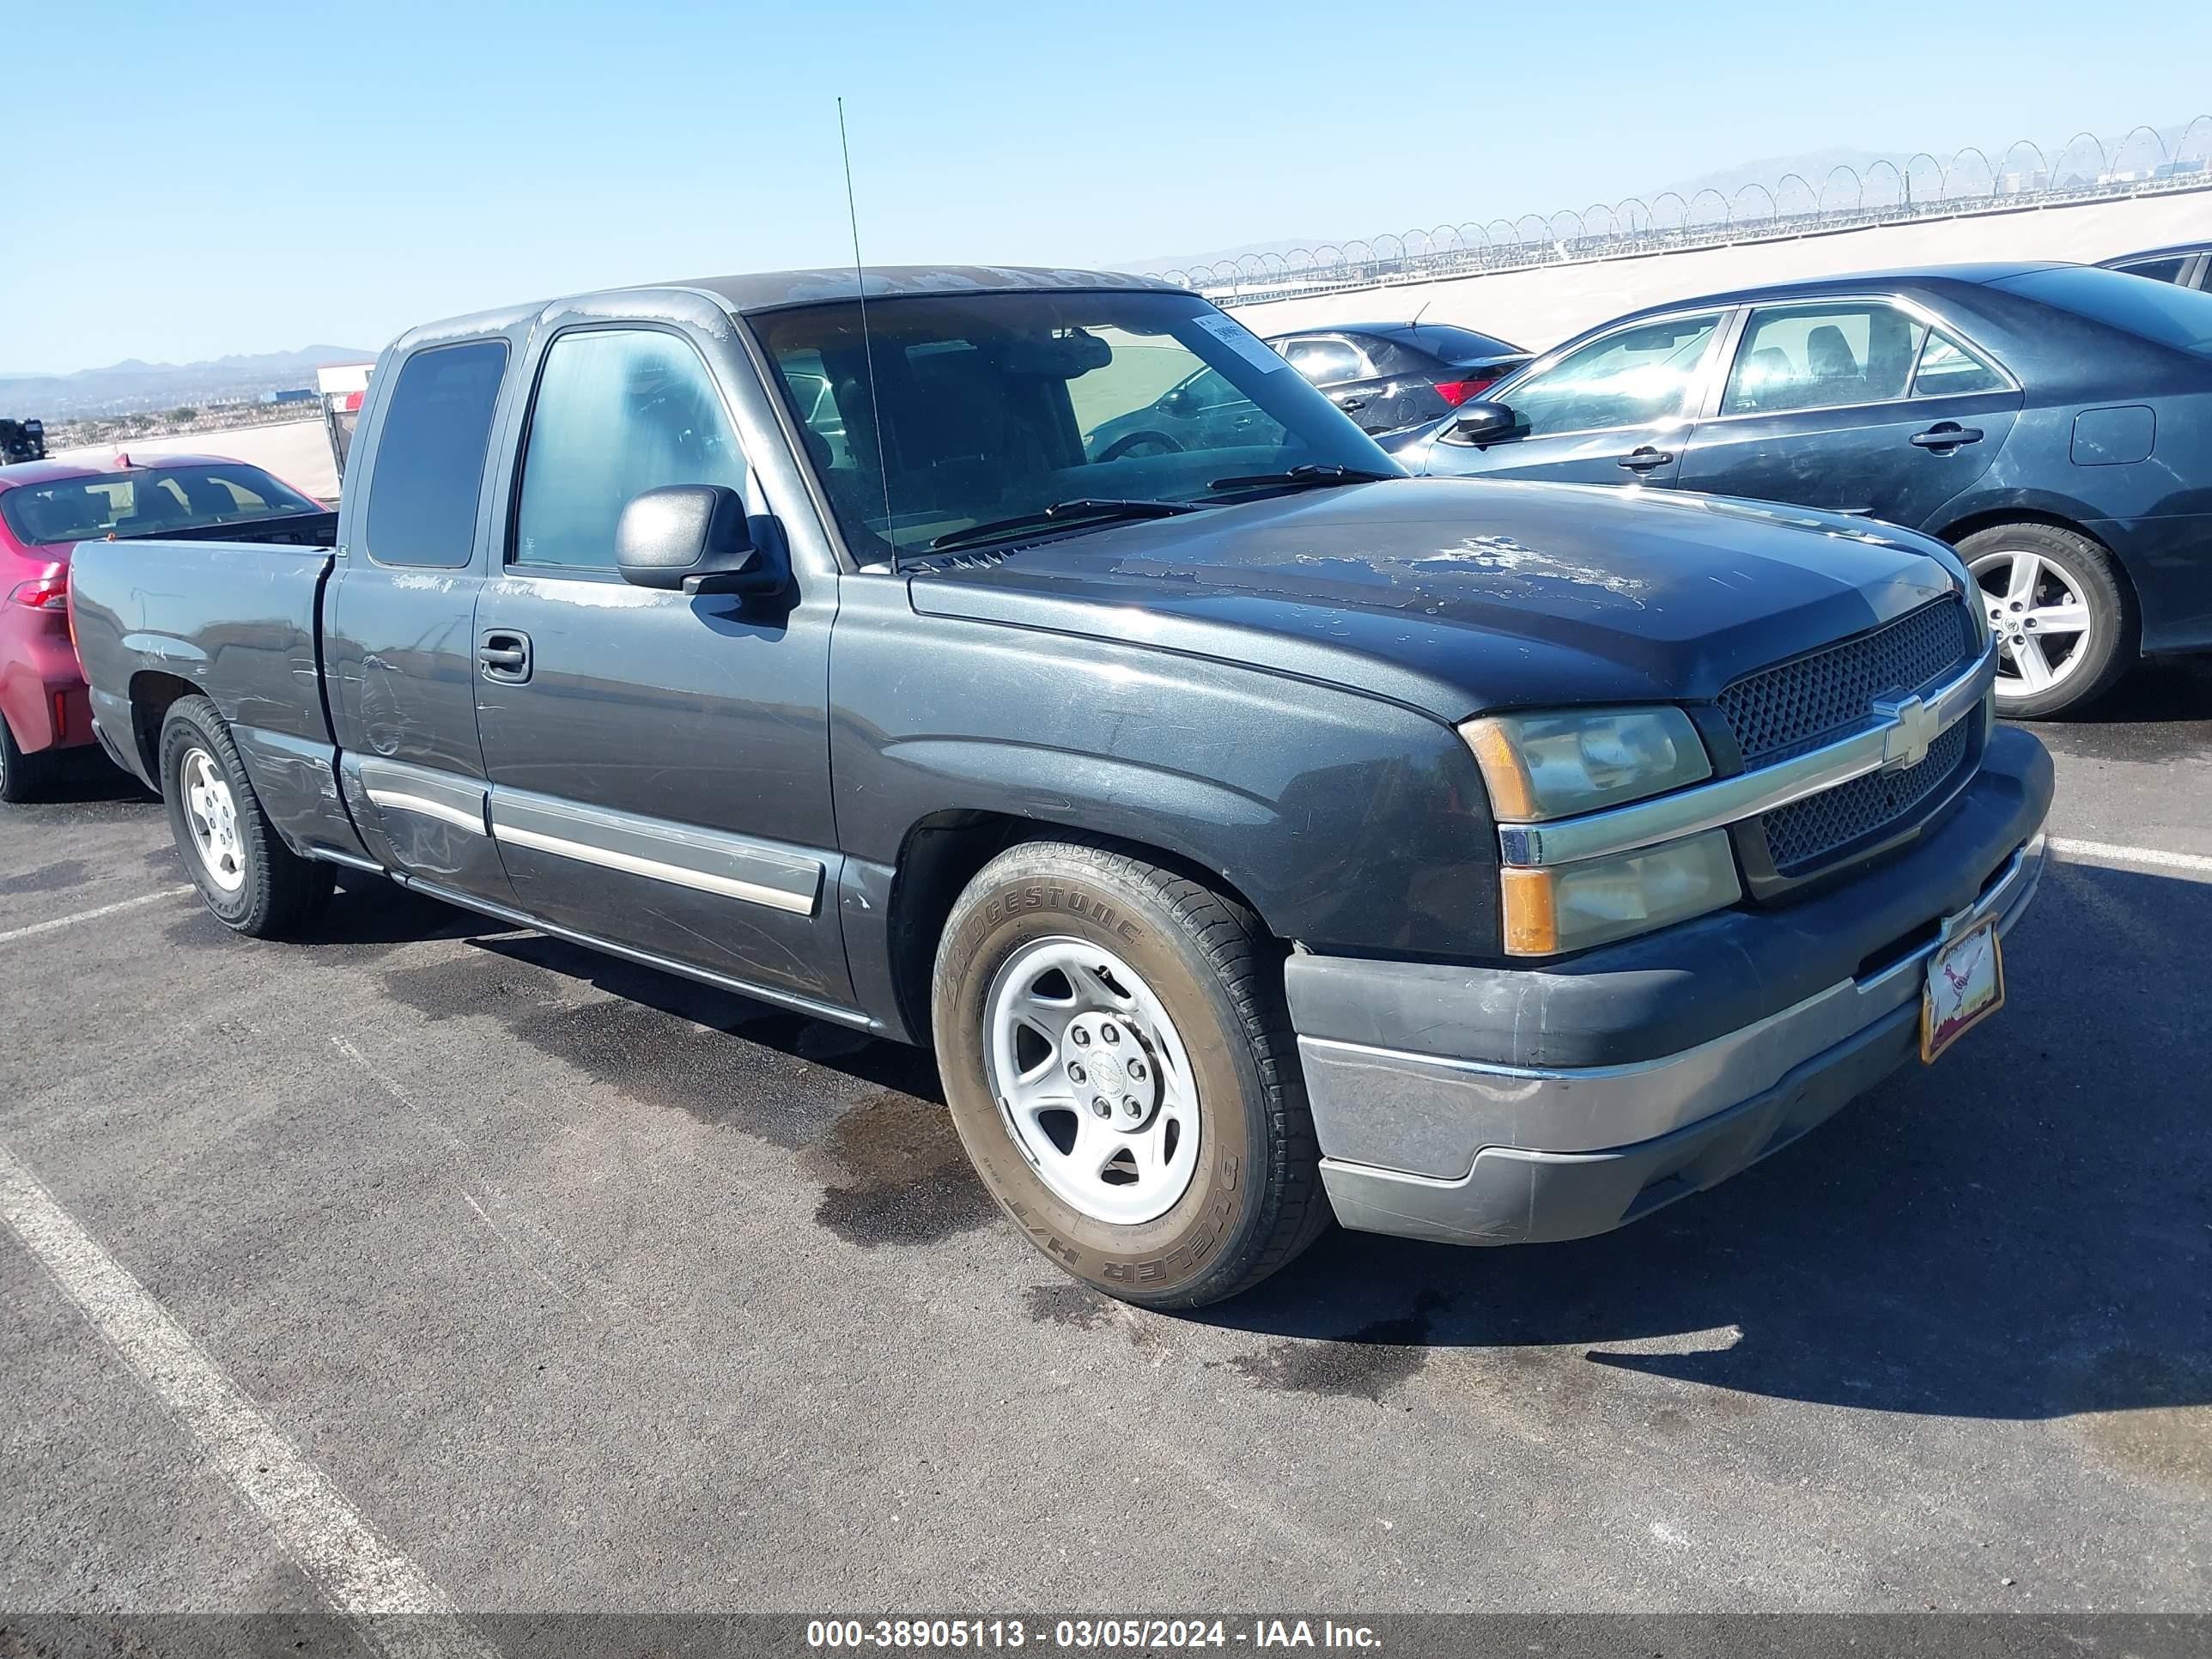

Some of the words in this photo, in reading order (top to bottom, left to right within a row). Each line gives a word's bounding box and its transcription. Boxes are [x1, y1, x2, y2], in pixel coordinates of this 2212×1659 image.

[944, 884, 1144, 1012] BRIDGESTONE
[1004, 1198, 1082, 1268] H/T
[1102, 1143, 1242, 1287] DUELER
